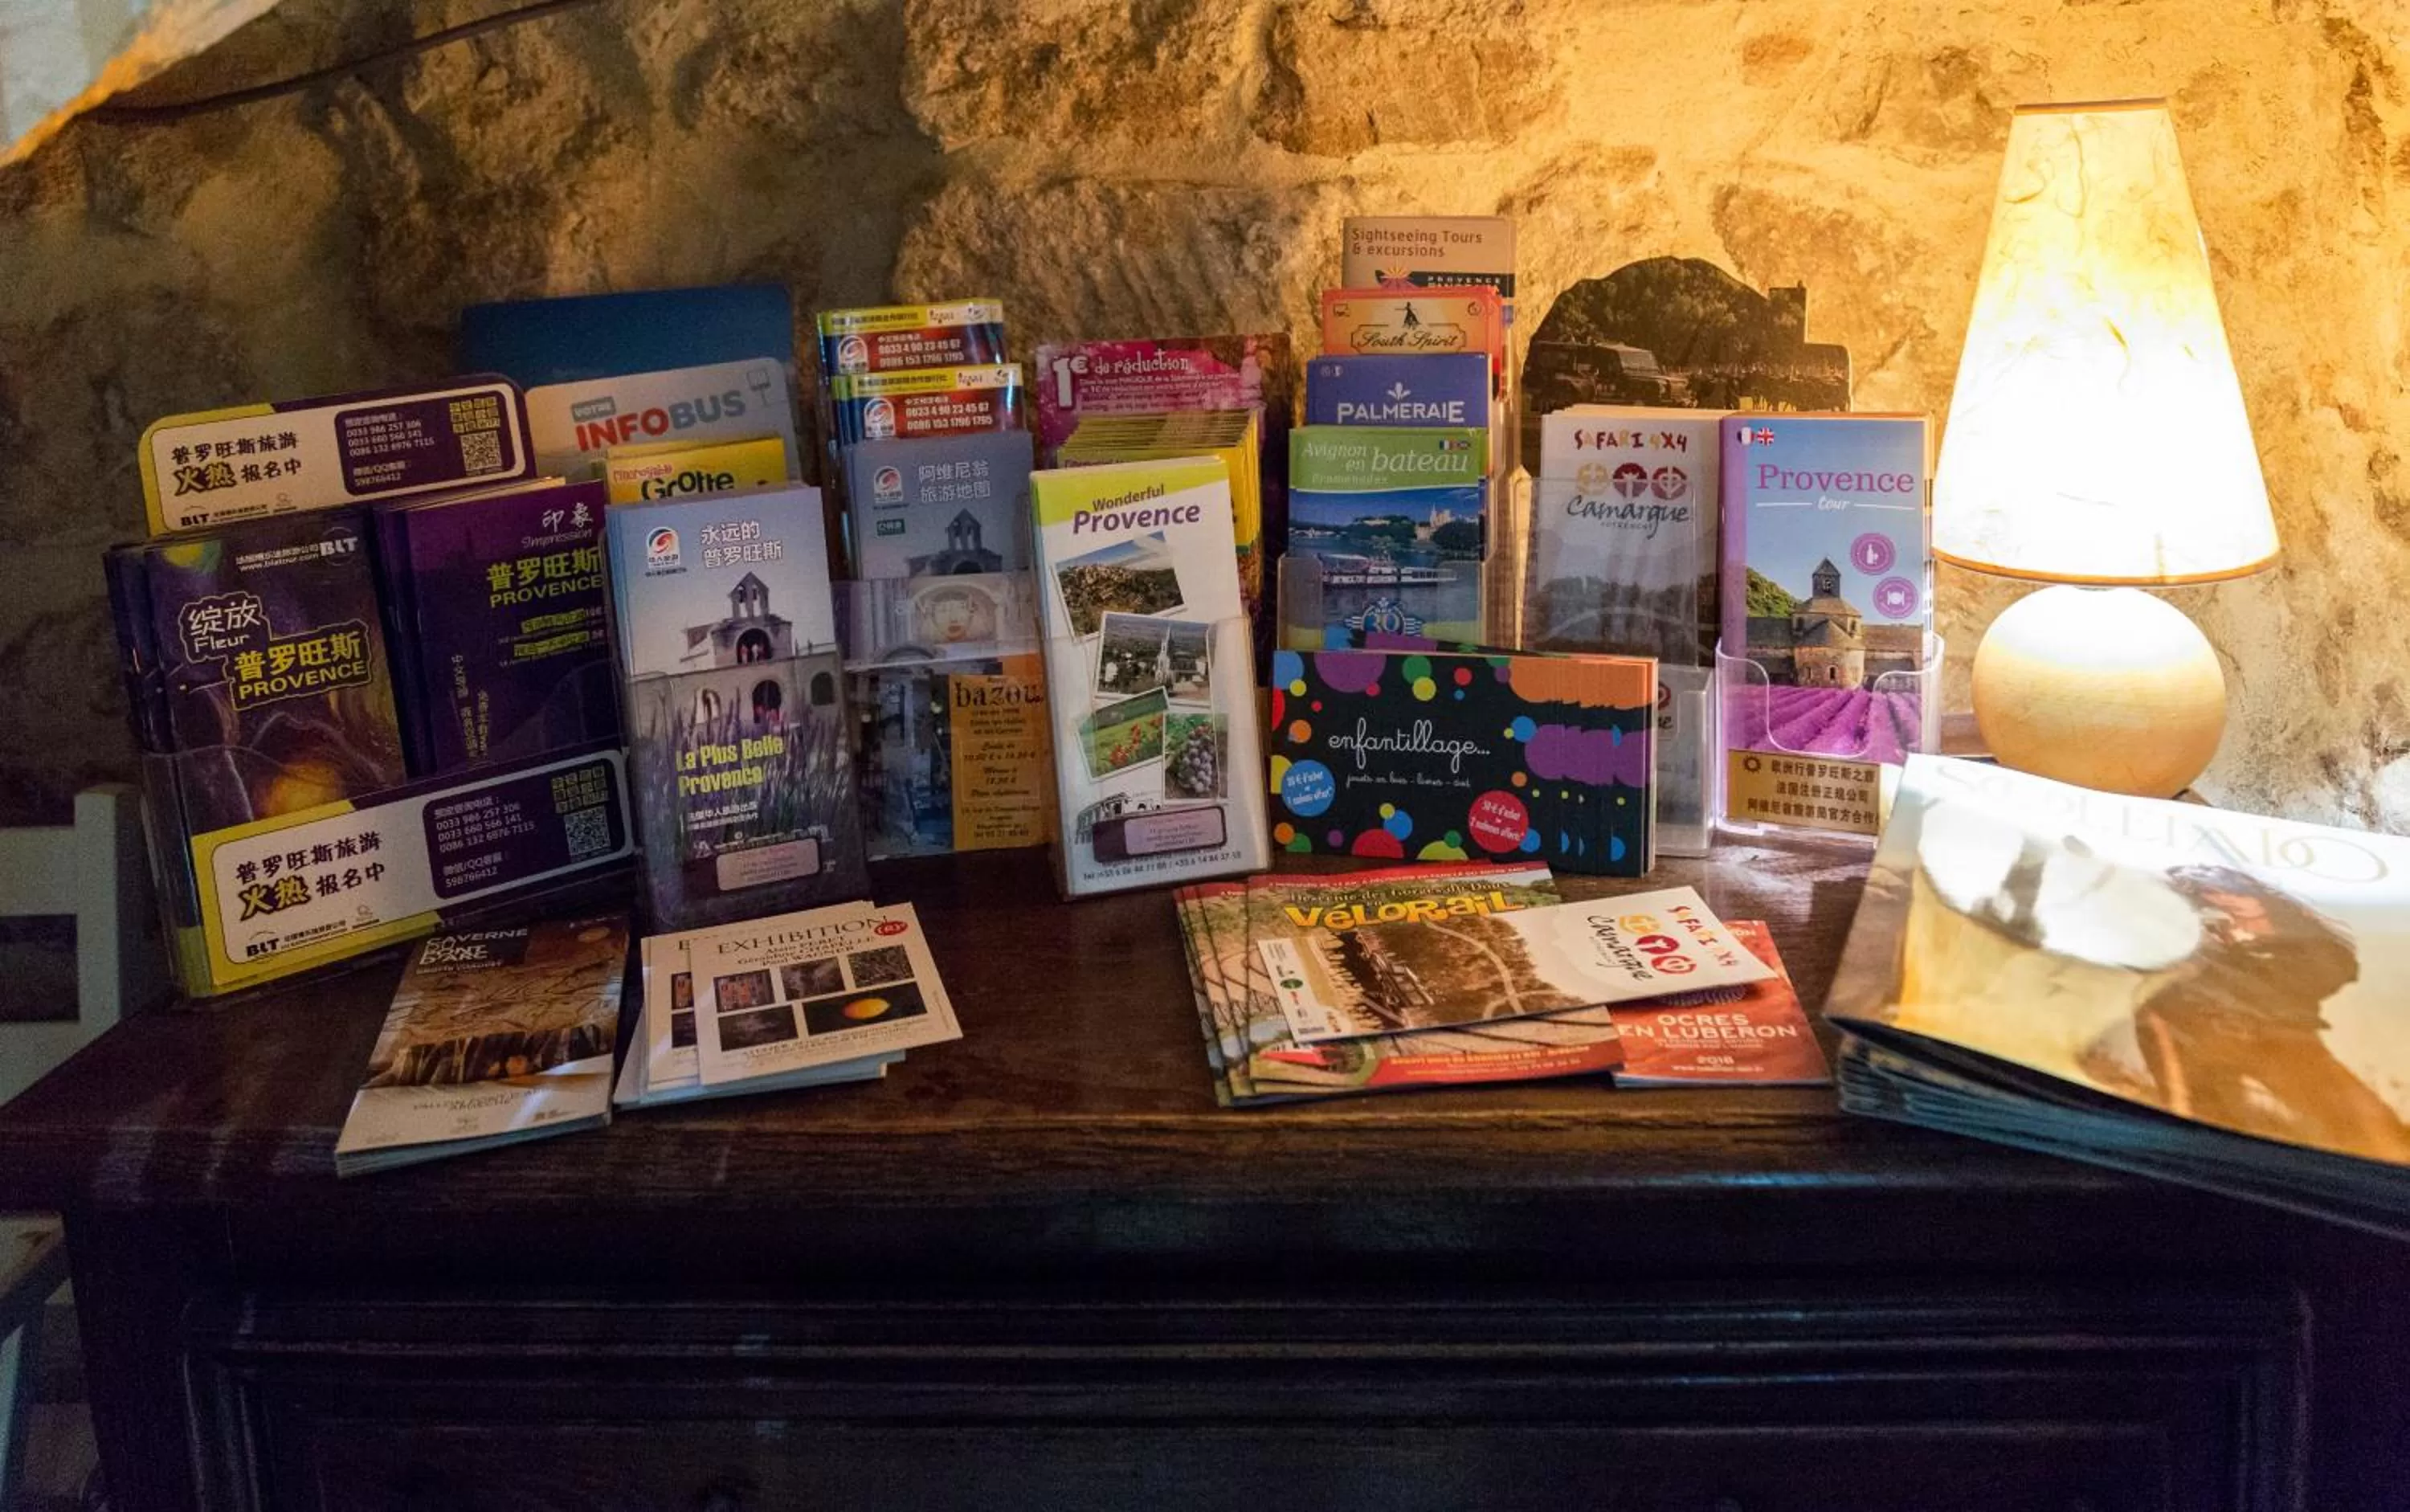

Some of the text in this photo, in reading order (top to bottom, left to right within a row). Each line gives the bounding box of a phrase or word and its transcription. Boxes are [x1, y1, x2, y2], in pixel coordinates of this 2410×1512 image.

[1351, 229, 1483, 243] Sightseeing Tours
[1352, 243, 1446, 257] & excursions
[1427, 275, 1501, 284] PROVENCE
[1357, 330, 1460, 349] South Spirit
[1113, 349, 1190, 375] réduction
[574, 390, 747, 452] INFOBUS
[1337, 401, 1466, 424] PALMERAIE
[171, 431, 298, 464] 普罗旺斯旅游
[1301, 442, 1367, 460] Avignon
[1574, 429, 1644, 451] SAFARI
[917, 459, 991, 482] 阿维尼翁
[1345, 447, 1469, 473] en bateau
[1755, 463, 1914, 493] Provence
[1091, 483, 1166, 512] Wonderful
[1816, 495, 1850, 511] tour
[1072, 504, 1201, 535] Provence
[1566, 494, 1690, 540] Camargue
[701, 521, 761, 545] 永远的
[702, 540, 782, 568] 普罗旺斯
[487, 546, 603, 592] 普罗旺斯
[489, 574, 604, 609] PROVENCE
[186, 599, 261, 637] 绽放
[194, 632, 251, 654] Fleur
[235, 630, 362, 683] 普罗旺斯
[238, 660, 367, 700] PROVENCE
[675, 734, 785, 773] La Plus Belle
[235, 831, 382, 885] 普罗旺斯旅游
[717, 914, 888, 955] EXHIBITION
[1618, 1023, 1799, 1040] EN LUBERON
[1656, 1013, 1750, 1027] OCRES
